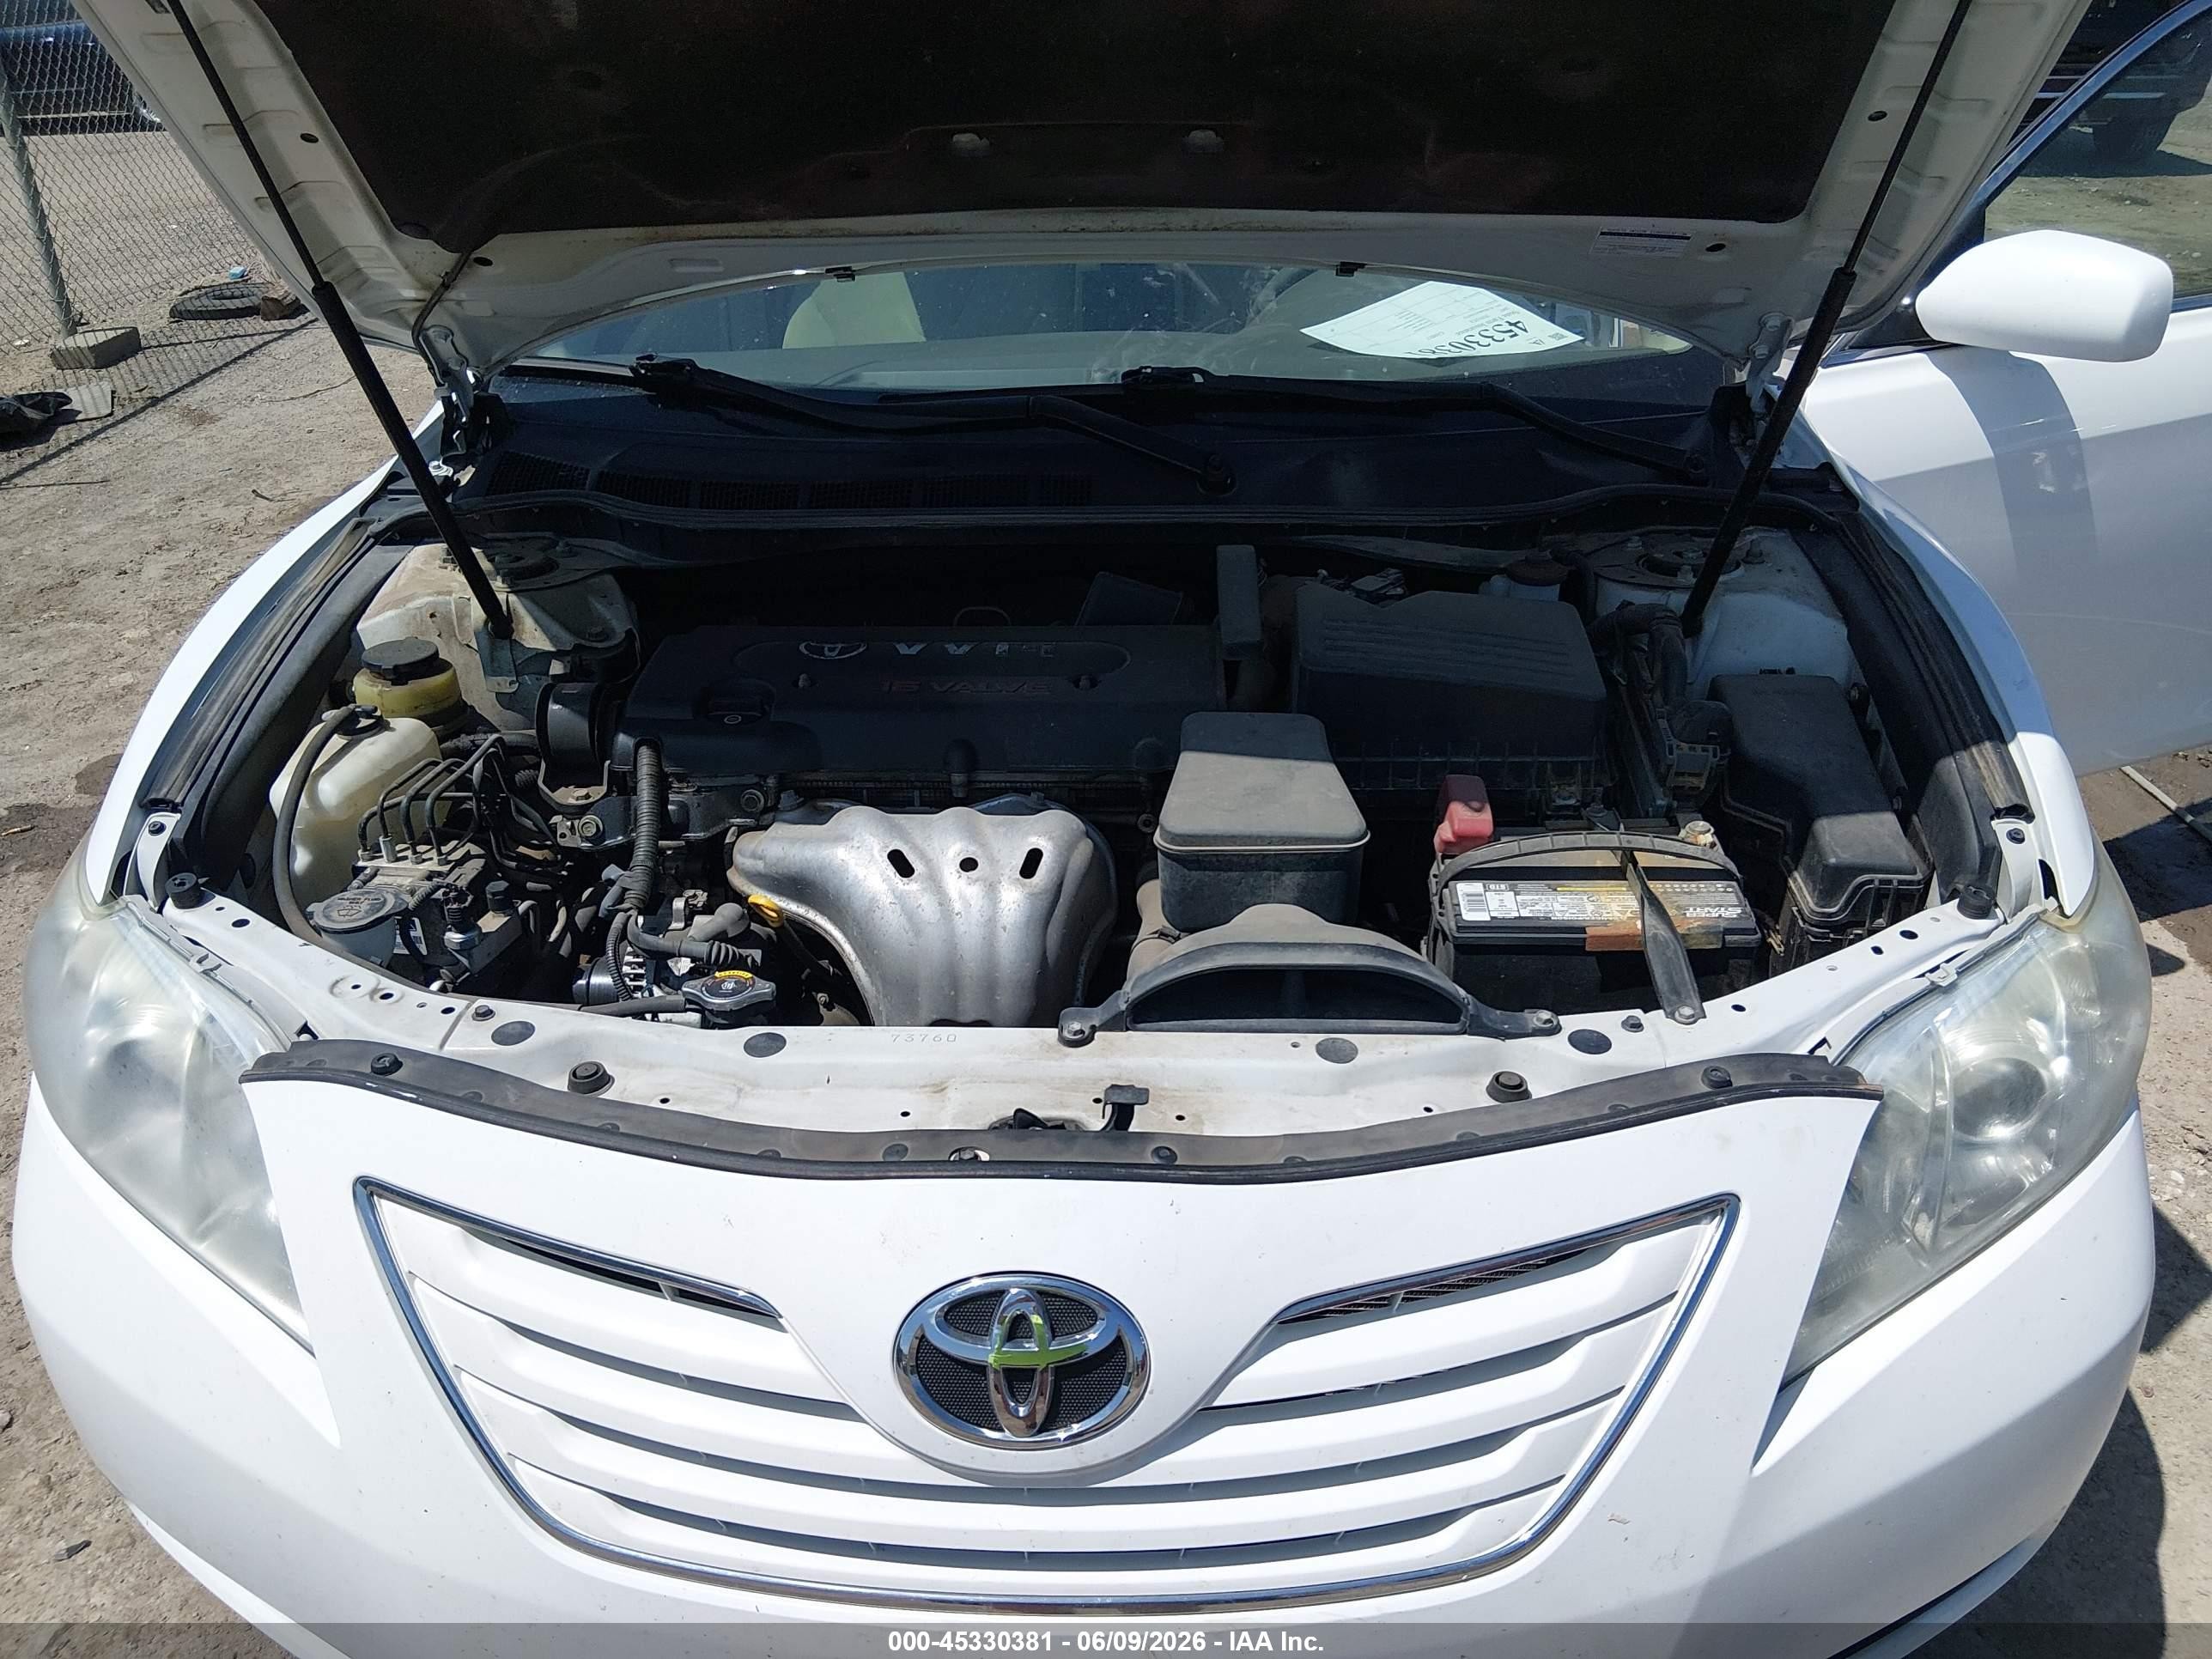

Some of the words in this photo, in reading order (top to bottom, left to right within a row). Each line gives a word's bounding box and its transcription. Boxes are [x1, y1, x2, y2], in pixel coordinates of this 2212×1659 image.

[1404, 319, 1530, 358] 45330381
[927, 678, 1053, 694] VALVE
[890, 1033, 957, 1043] 73760
